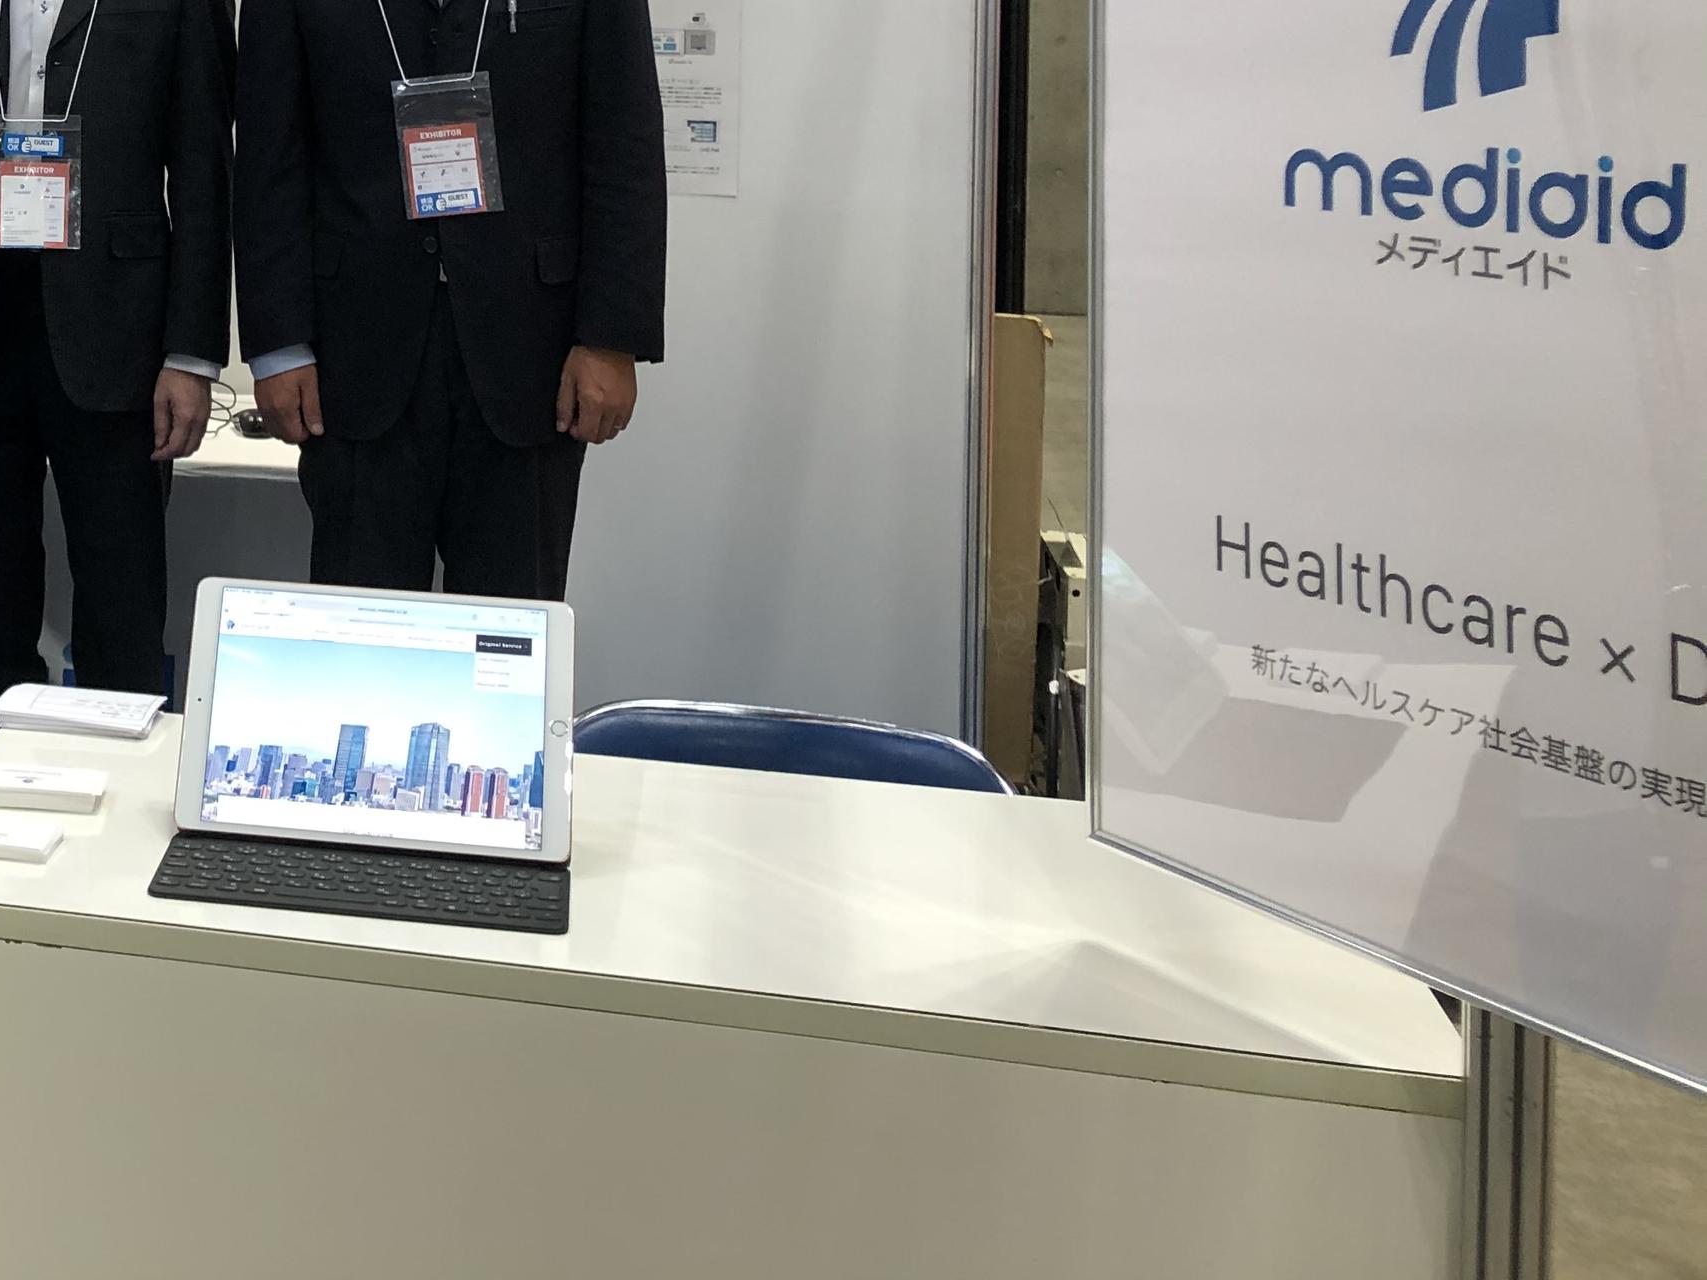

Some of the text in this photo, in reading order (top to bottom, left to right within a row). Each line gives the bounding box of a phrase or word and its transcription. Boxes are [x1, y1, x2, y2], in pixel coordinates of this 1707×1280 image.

[420, 129, 461, 140] EXHIBITOR
[1284, 147, 1687, 250] mediaid
[1376, 233, 1571, 289] メディエイド
[1215, 515, 1570, 667] Healthcare
[1251, 643, 1707, 818] 新たなヘルスケア社会基盤の実現
